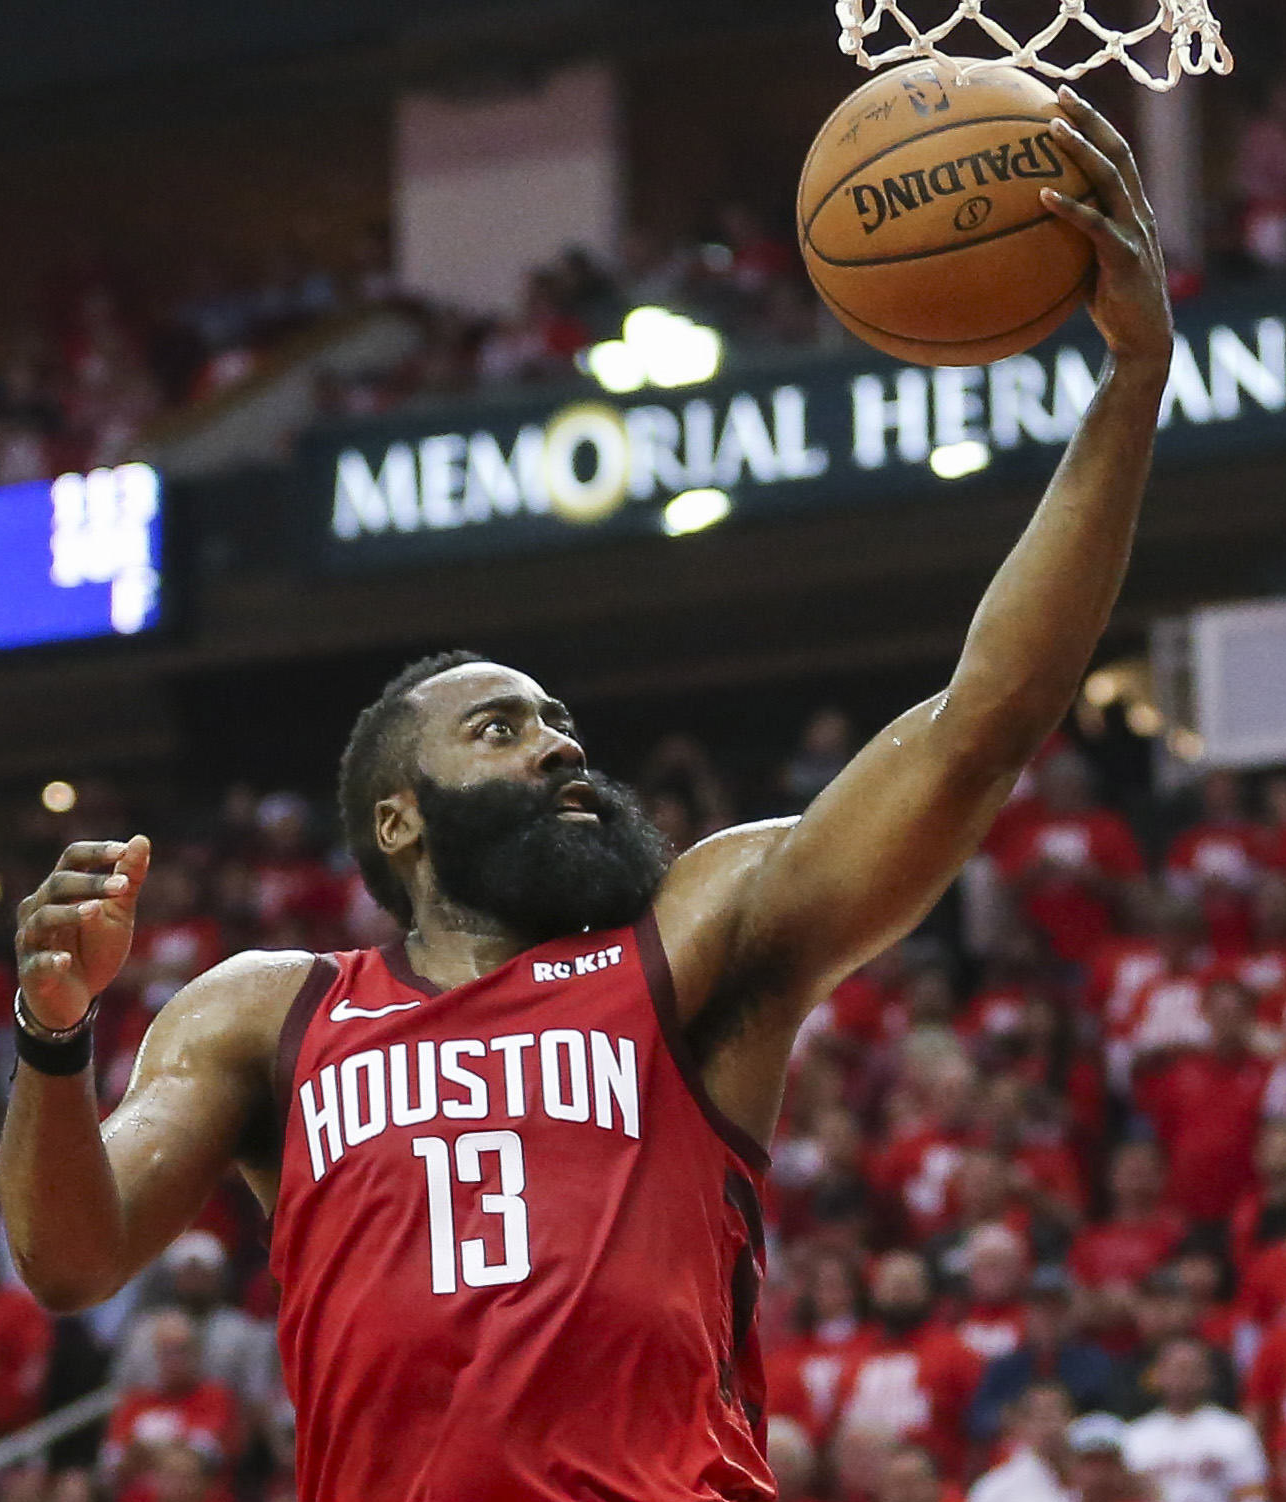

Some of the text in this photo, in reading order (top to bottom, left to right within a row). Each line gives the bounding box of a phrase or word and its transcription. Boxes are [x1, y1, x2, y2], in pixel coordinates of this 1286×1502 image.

[851, 130, 1064, 236] SPALDING
[332, 383, 830, 541] MEMORIAL
[299, 1028, 641, 1183] HOUSTON
[412, 1129, 531, 1295] 13
